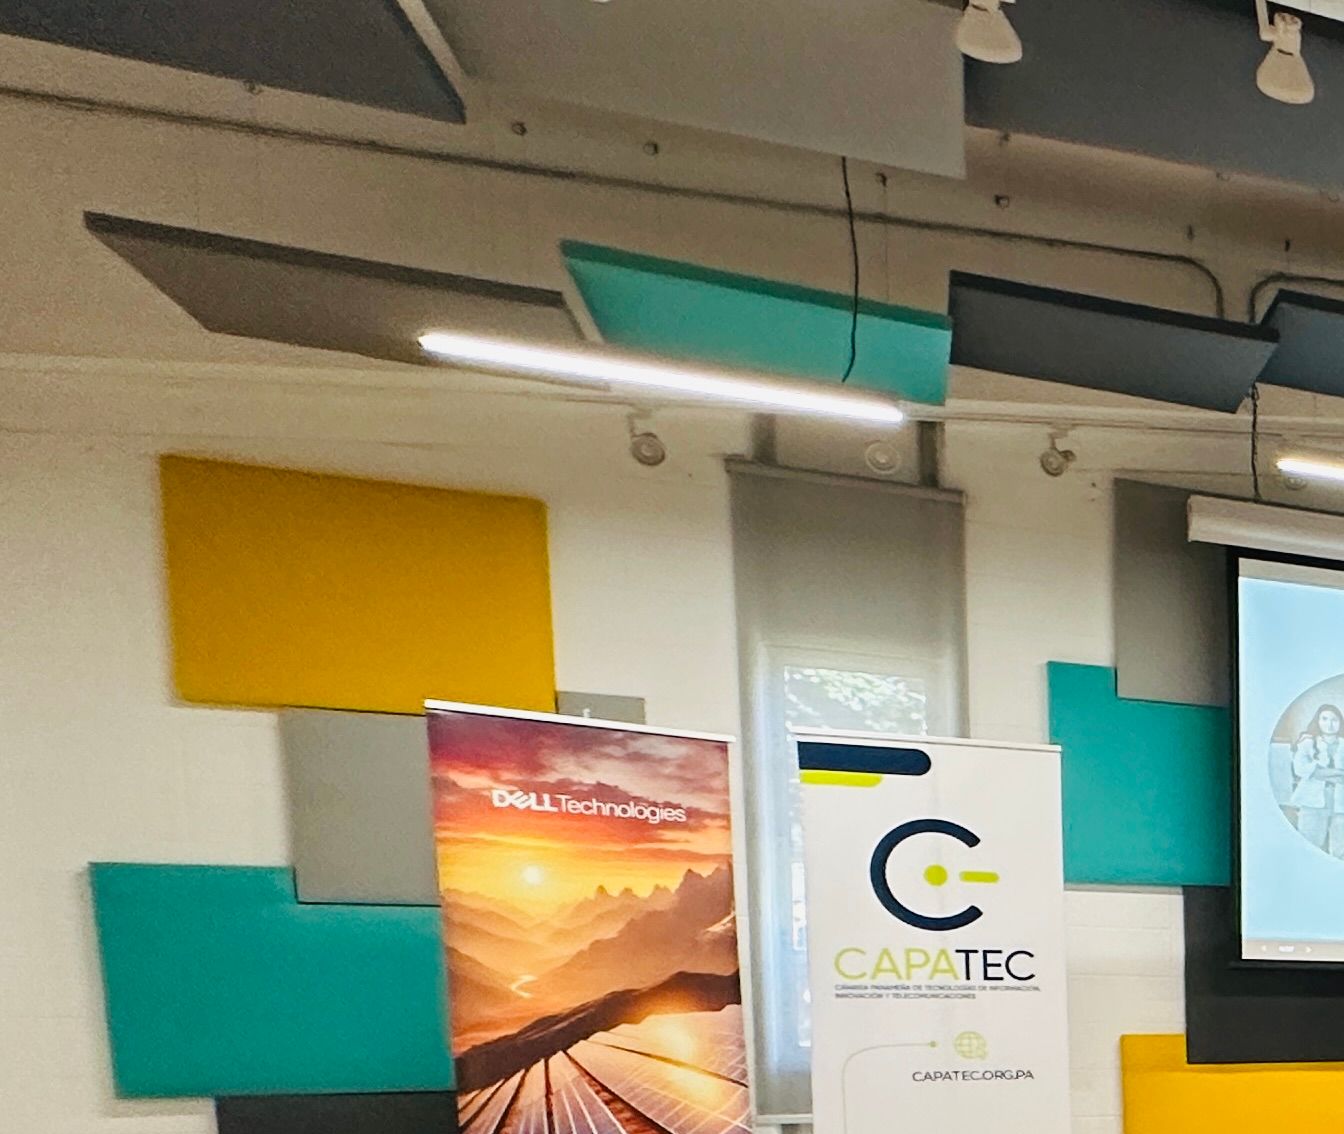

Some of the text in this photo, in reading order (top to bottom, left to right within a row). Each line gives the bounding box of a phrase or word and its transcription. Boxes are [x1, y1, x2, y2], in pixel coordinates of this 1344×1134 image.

[491, 789, 687, 824] DELL Technologies
[834, 947, 1036, 981] CAPATEC
[912, 1069, 1035, 1082] CAPATEC.ORG.PA
